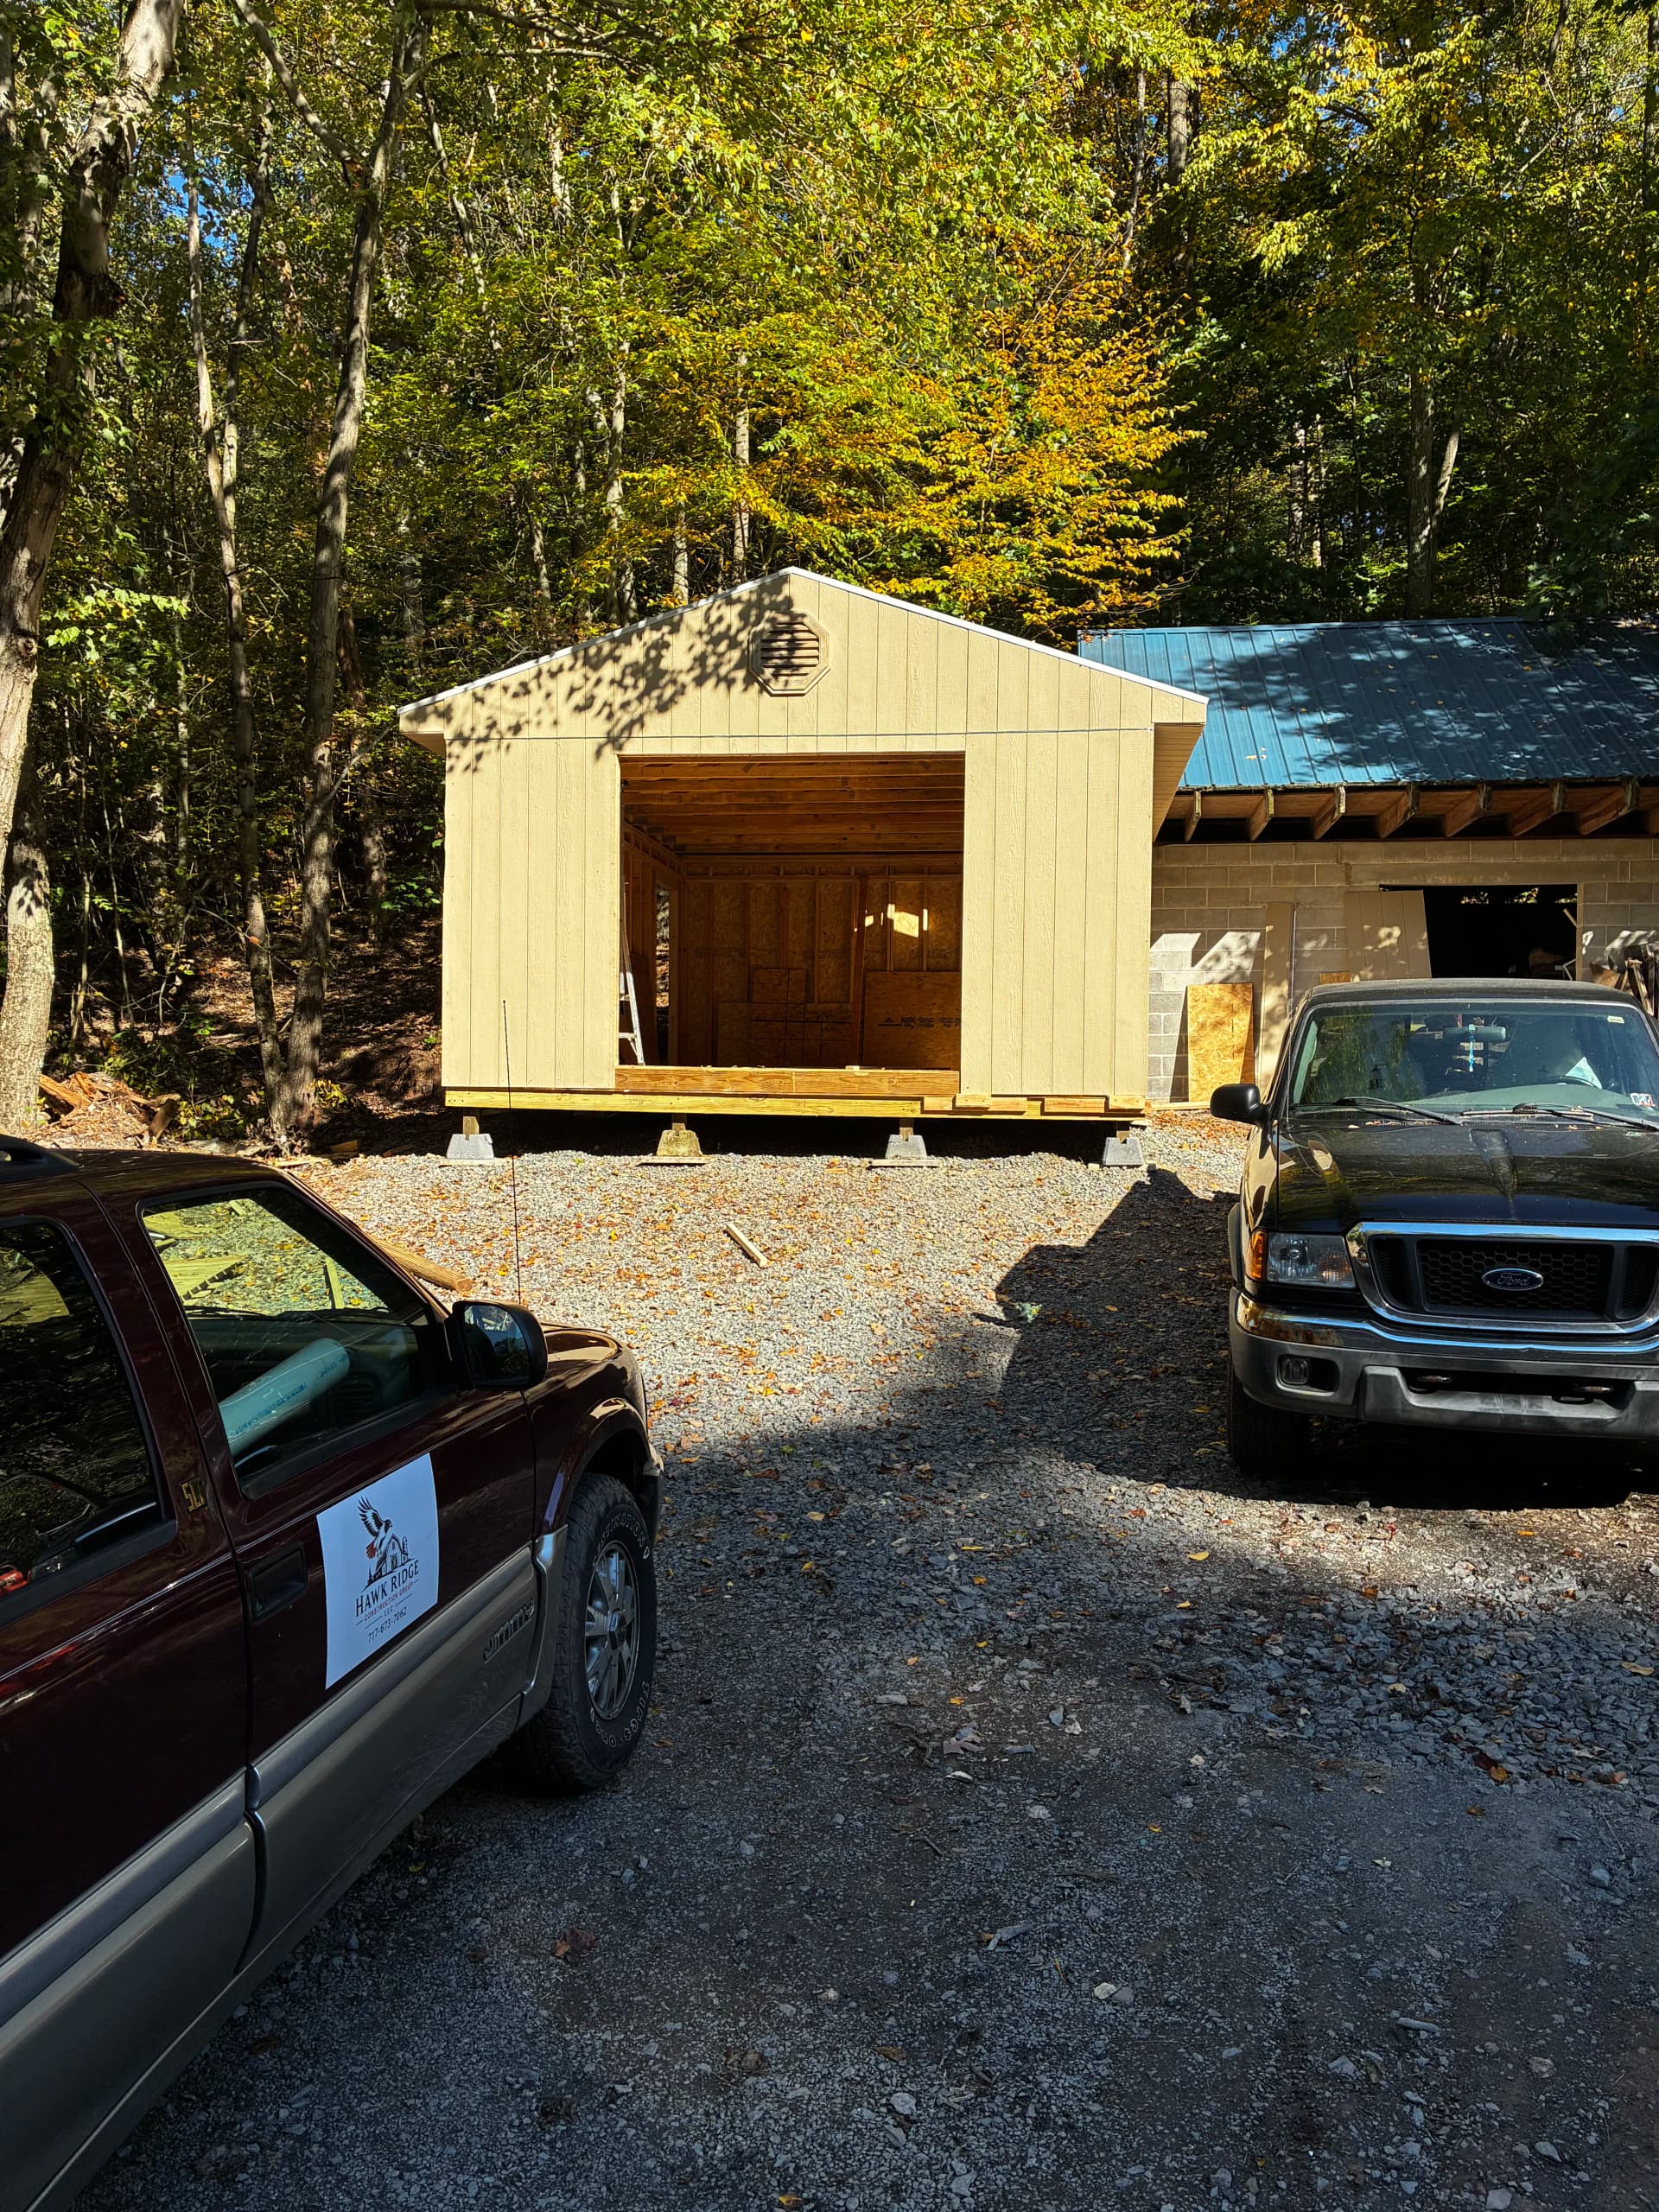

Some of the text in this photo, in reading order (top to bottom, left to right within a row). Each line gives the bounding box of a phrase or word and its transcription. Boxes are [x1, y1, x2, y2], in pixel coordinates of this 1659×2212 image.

[1497, 1272, 1531, 1286] Ford
[355, 1559, 419, 1618] HAWK RIDGE
[364, 1582, 413, 1622] CONSTRUCTION GROUP
[368, 1606, 407, 1643] 717-673-7062
[384, 1605, 393, 1617] LLC
